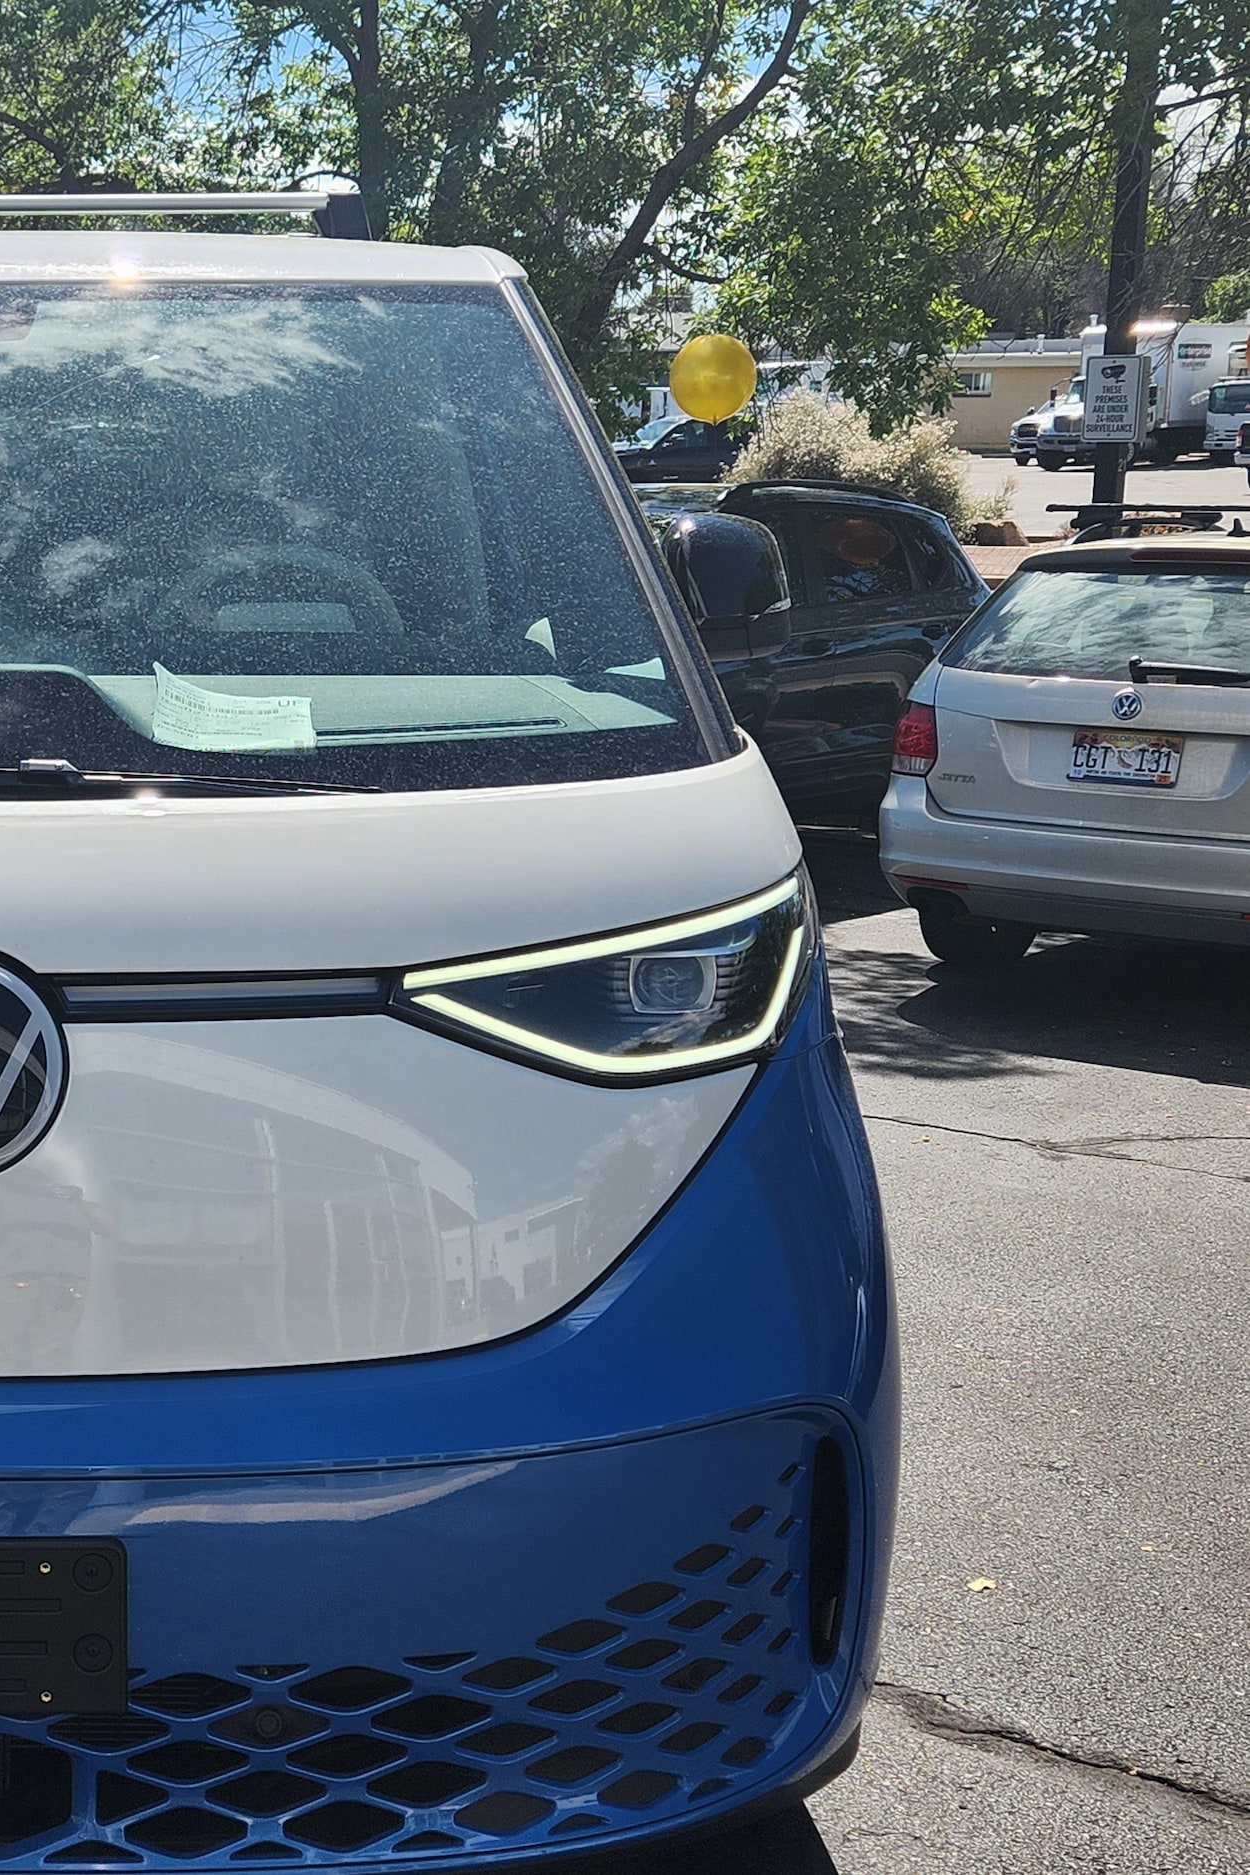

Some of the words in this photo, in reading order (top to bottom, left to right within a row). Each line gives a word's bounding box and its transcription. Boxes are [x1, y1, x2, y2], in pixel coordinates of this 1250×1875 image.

[1102, 385, 1122, 394] THESE
[1095, 395, 1128, 403] PREMISES
[1093, 405, 1106, 413] ARE
[1107, 405, 1129, 413] UNDER
[1095, 414, 1124, 423] 24-HOUR
[1085, 424, 1133, 433] SURVEILLANCE
[1072, 745, 1113, 769] CGT
